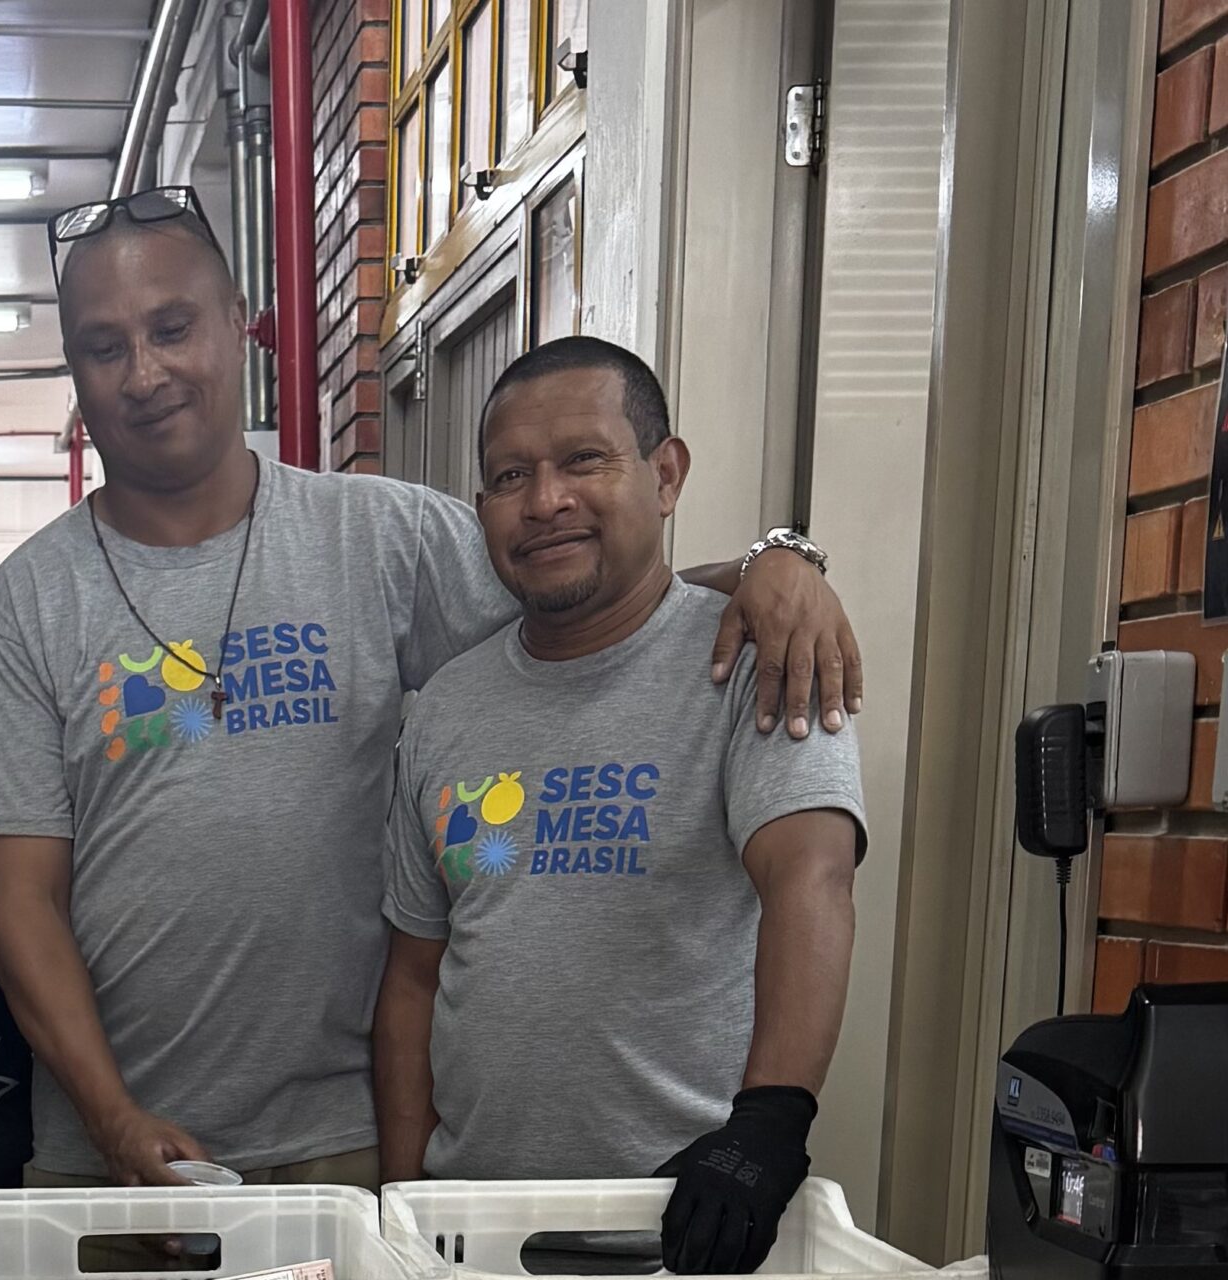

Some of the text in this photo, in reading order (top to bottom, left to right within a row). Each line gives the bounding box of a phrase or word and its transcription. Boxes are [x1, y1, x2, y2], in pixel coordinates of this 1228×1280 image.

[219, 623, 329, 666] SESC
[222, 659, 337, 705] MESA
[226, 698, 339, 735] BRASIL
[539, 763, 660, 803] SESC
[535, 805, 650, 844] MESA
[530, 847, 646, 875] BRASIL
